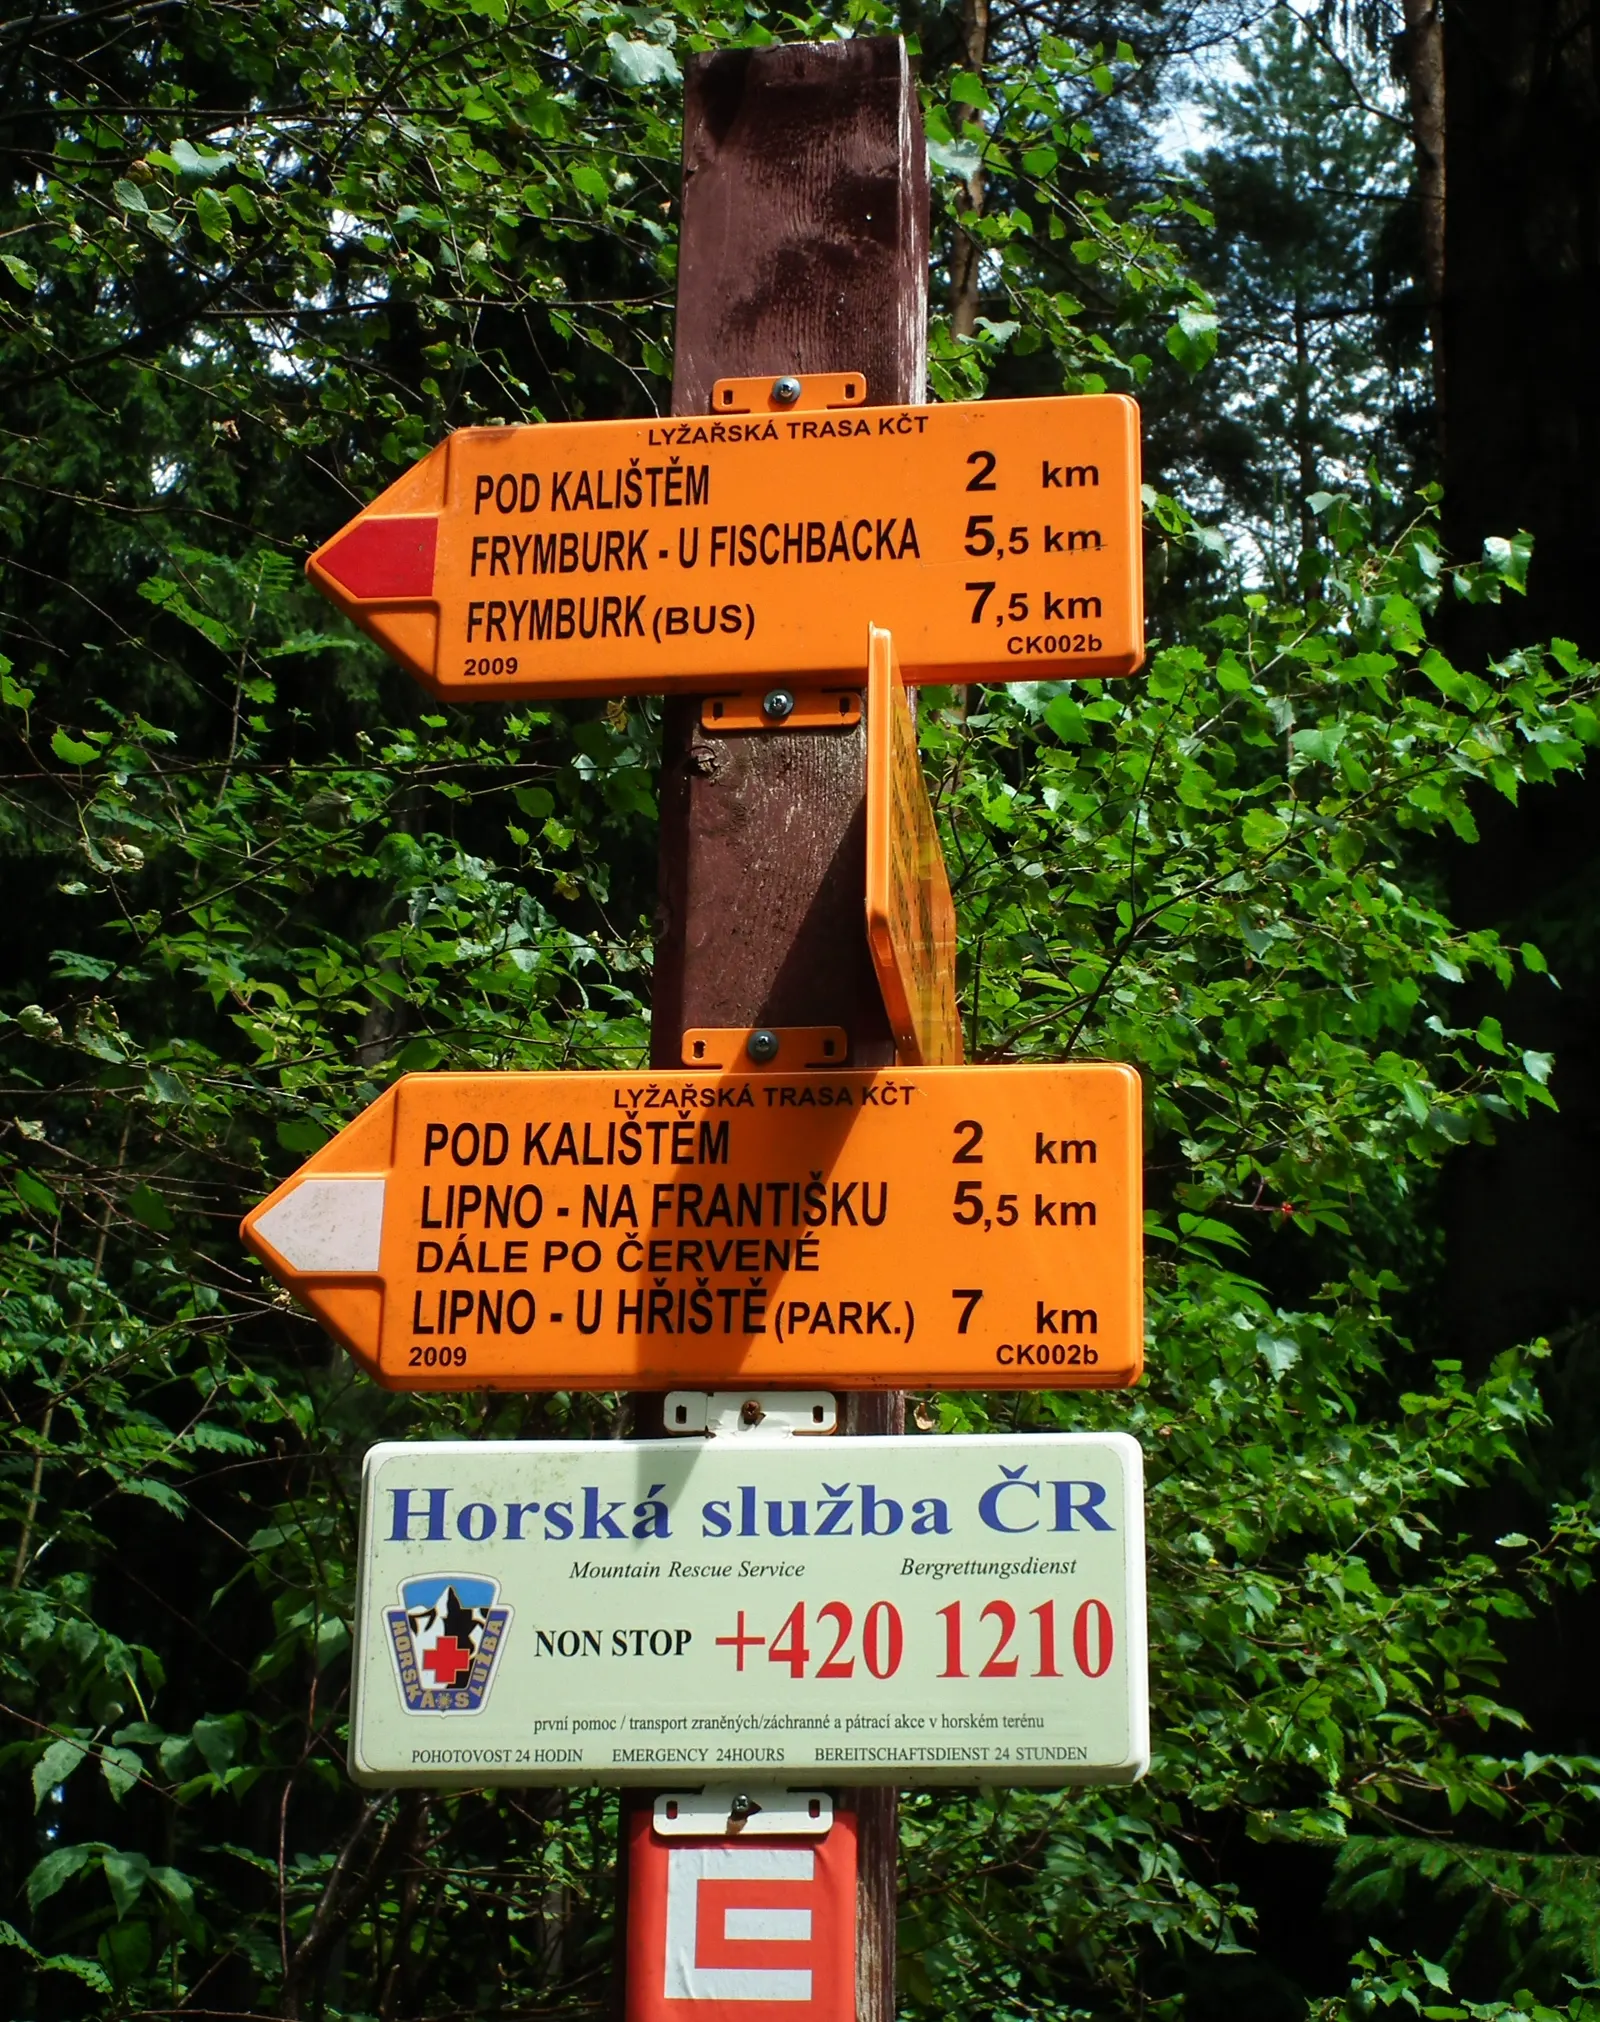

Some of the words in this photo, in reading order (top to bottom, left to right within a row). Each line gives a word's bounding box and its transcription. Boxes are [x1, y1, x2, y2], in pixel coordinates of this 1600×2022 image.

[649, 419, 779, 446] LYŽAŘSKÁ
[786, 420, 870, 439] TRASA
[879, 415, 929, 435] KČT
[475, 473, 540, 515] POD
[551, 456, 709, 512] KALIŠTĚM
[966, 451, 996, 492] 2
[1042, 461, 1099, 488] km
[471, 529, 649, 577] FRYMBURK
[679, 527, 698, 568] U
[711, 518, 920, 567] FISCHBACKA
[1044, 525, 1101, 553] km
[467, 595, 646, 643] FRYMBURK
[1044, 592, 1101, 620] km
[1007, 634, 1102, 655] CK002b
[464, 657, 518, 676] 2009
[614, 1084, 757, 1111] LYŽAŘSKÁ
[764, 1086, 853, 1107] TRASA
[860, 1084, 916, 1108] KČT
[424, 1123, 508, 1167] POD
[523, 1109, 731, 1168] KALIŠTĚM
[952, 1120, 983, 1164] 2
[1035, 1132, 1096, 1164] km
[421, 1184, 542, 1229] LIPNO
[582, 1184, 638, 1228] NA
[651, 1169, 887, 1229] FRANTIŠKU
[1035, 1194, 1096, 1226] km
[417, 1233, 528, 1273] DÁLE
[543, 1240, 601, 1273] PO
[617, 1230, 819, 1274] ČERVENÉ
[413, 1289, 535, 1335] LIPNO
[577, 1289, 602, 1335] U
[618, 1278, 767, 1335] HŘIŠTĚ
[952, 1289, 984, 1334] 7
[1037, 1301, 1097, 1334] km
[408, 1347, 466, 1367] 2009
[996, 1344, 1098, 1366] CK002b
[384, 1481, 673, 1541] Horská
[702, 1483, 951, 1537] služba
[979, 1465, 1116, 1533] ČR
[569, 1562, 660, 1578] Mountain
[668, 1561, 732, 1577] Rescue
[738, 1561, 805, 1577] Service
[900, 1557, 1077, 1580] Bergrettungsdienst
[535, 1630, 603, 1657] NON
[612, 1629, 692, 1656] STOP
[716, 1601, 903, 1679] +420
[936, 1599, 1113, 1678] 1210
[534, 1716, 568, 1735] první
[572, 1720, 616, 1734] pomoc
[630, 1717, 687, 1734] transport
[834, 1718, 841, 1728] a
[846, 1714, 890, 1733] pátrací
[895, 1714, 925, 1728] akce
[929, 1718, 936, 1728] v
[942, 1713, 998, 1728] horském
[1003, 1713, 1044, 1728] terénu
[412, 1749, 512, 1763] POHOTOVOST
[515, 1749, 530, 1762] 24
[534, 1749, 583, 1762] HODIN
[612, 1748, 709, 1762] EMERGENCY
[716, 1748, 784, 1761] 24HOURS
[815, 1747, 990, 1761] BEREITSCHAFTSDIENST
[995, 1747, 1010, 1760] 24
[1016, 1747, 1087, 1760] STUNDEN
